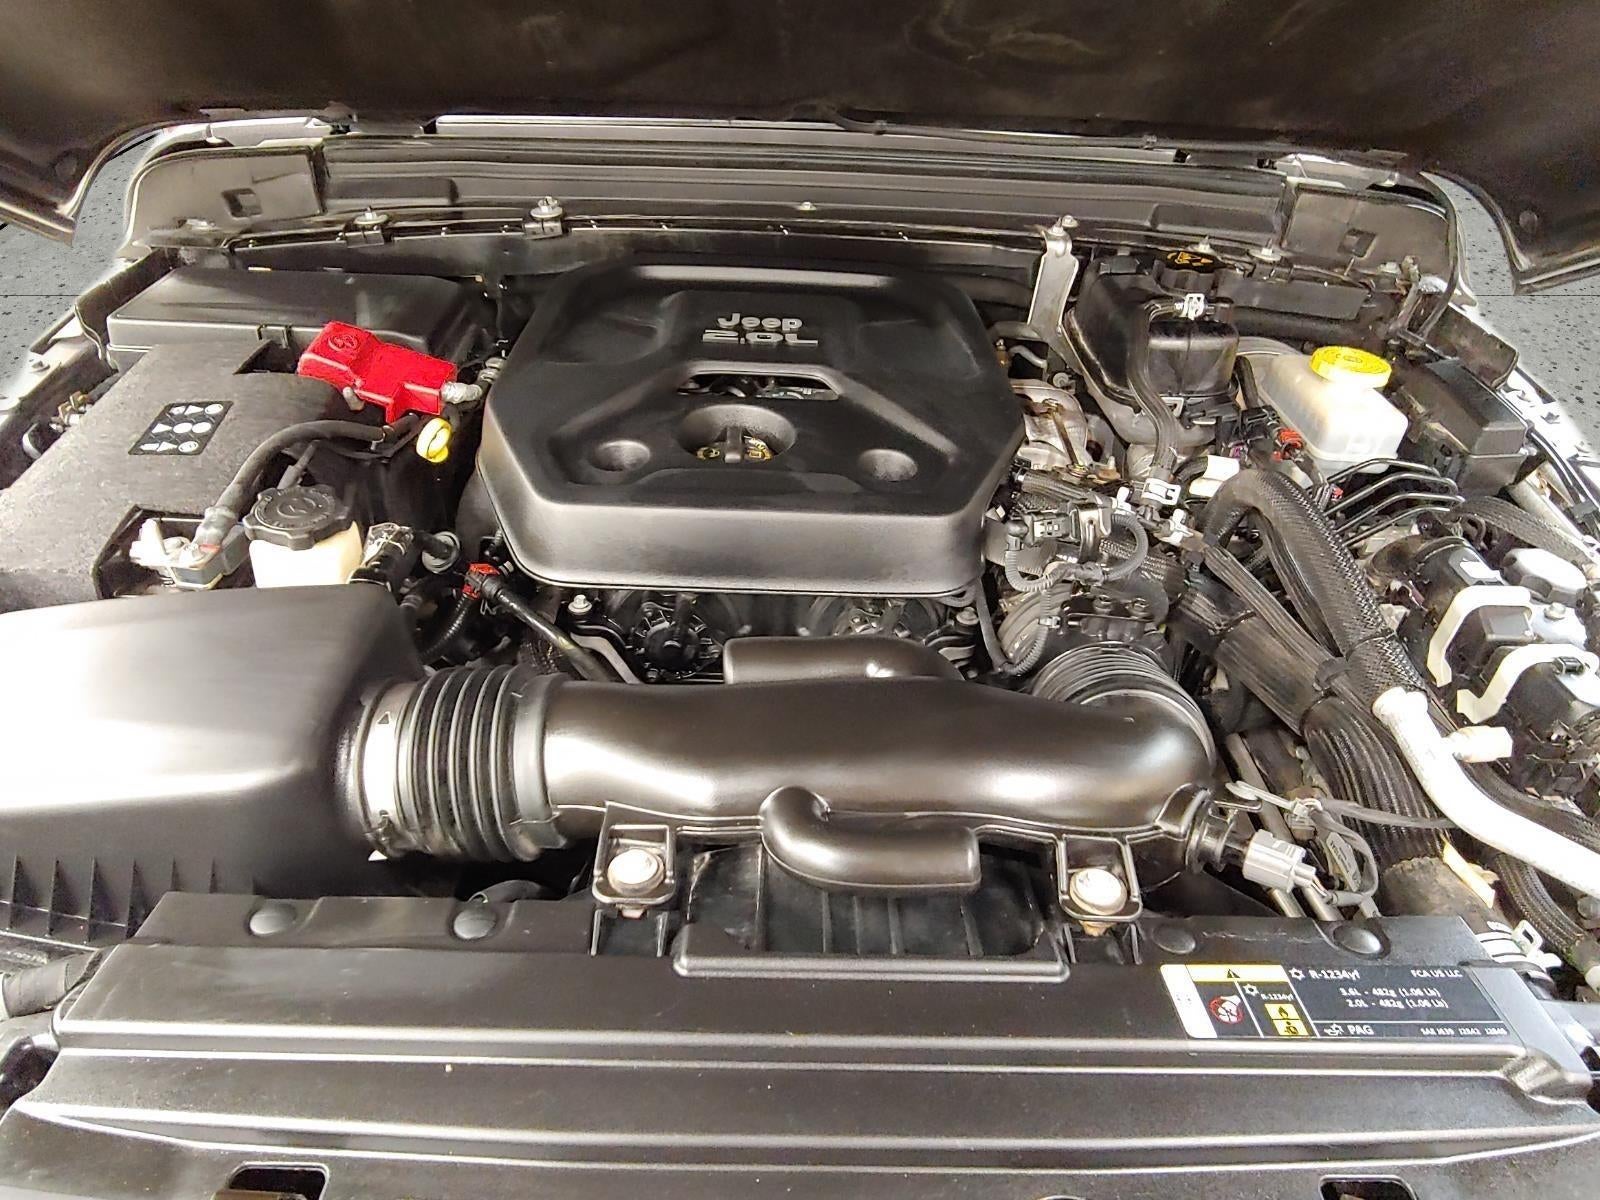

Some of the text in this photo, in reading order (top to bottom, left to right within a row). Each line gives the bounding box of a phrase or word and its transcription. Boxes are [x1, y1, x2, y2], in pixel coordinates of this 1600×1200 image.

[717, 312, 803, 332] Jeep
[702, 329, 819, 346] 2.0L
[1308, 969, 1361, 981] R-1234yf
[1410, 969, 1463, 978] FCA US LLC
[1345, 999, 1369, 1008] 2.0L
[1346, 1024, 1375, 1036] PAG
